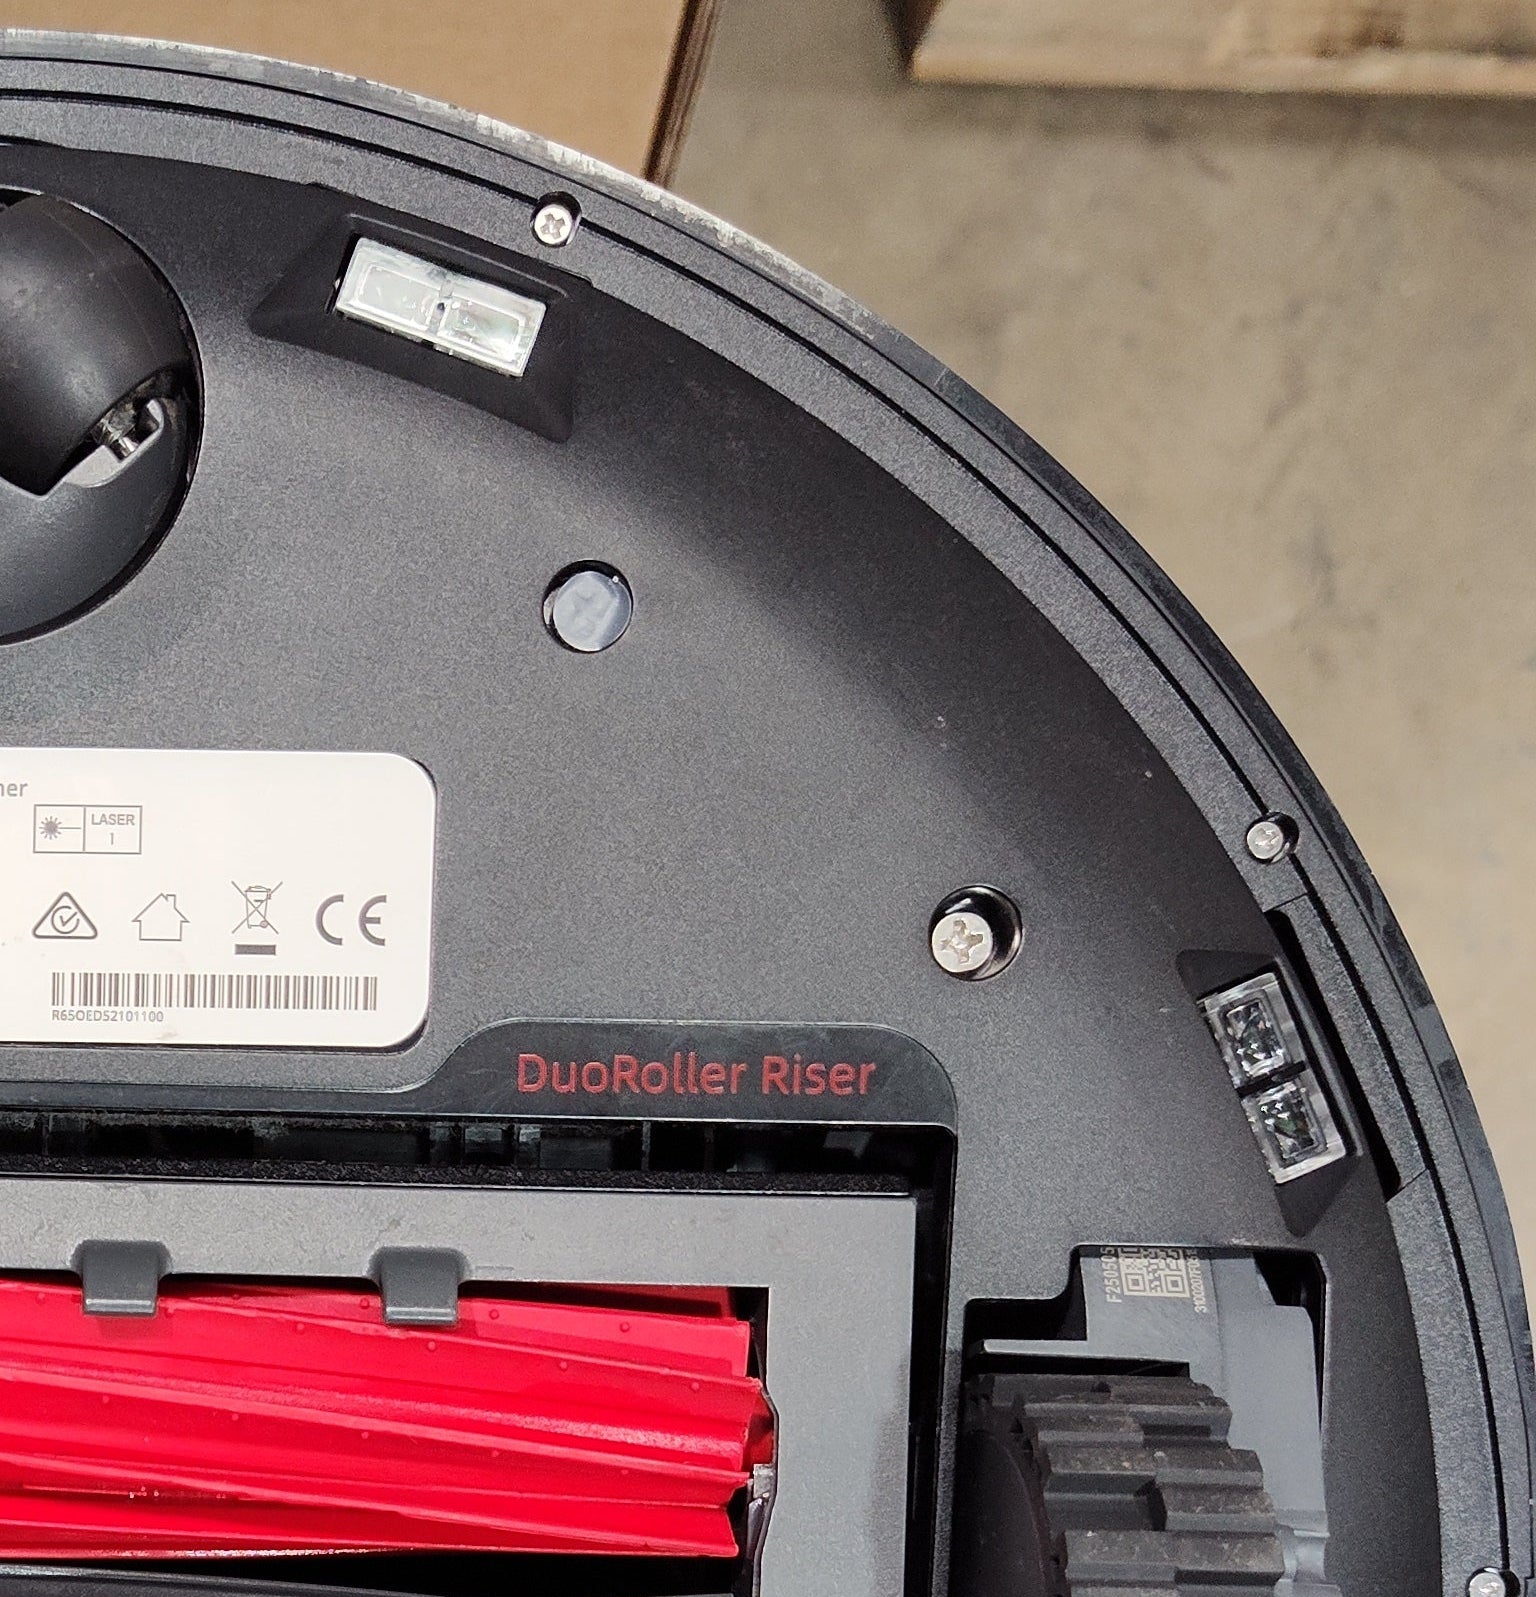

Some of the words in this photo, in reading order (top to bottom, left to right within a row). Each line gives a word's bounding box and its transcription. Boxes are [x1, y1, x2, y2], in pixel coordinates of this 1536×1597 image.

[91, 813, 136, 826] LASER
[315, 894, 387, 947] CE
[517, 1052, 747, 1095] DuoRoller
[762, 1054, 877, 1096] Riser
